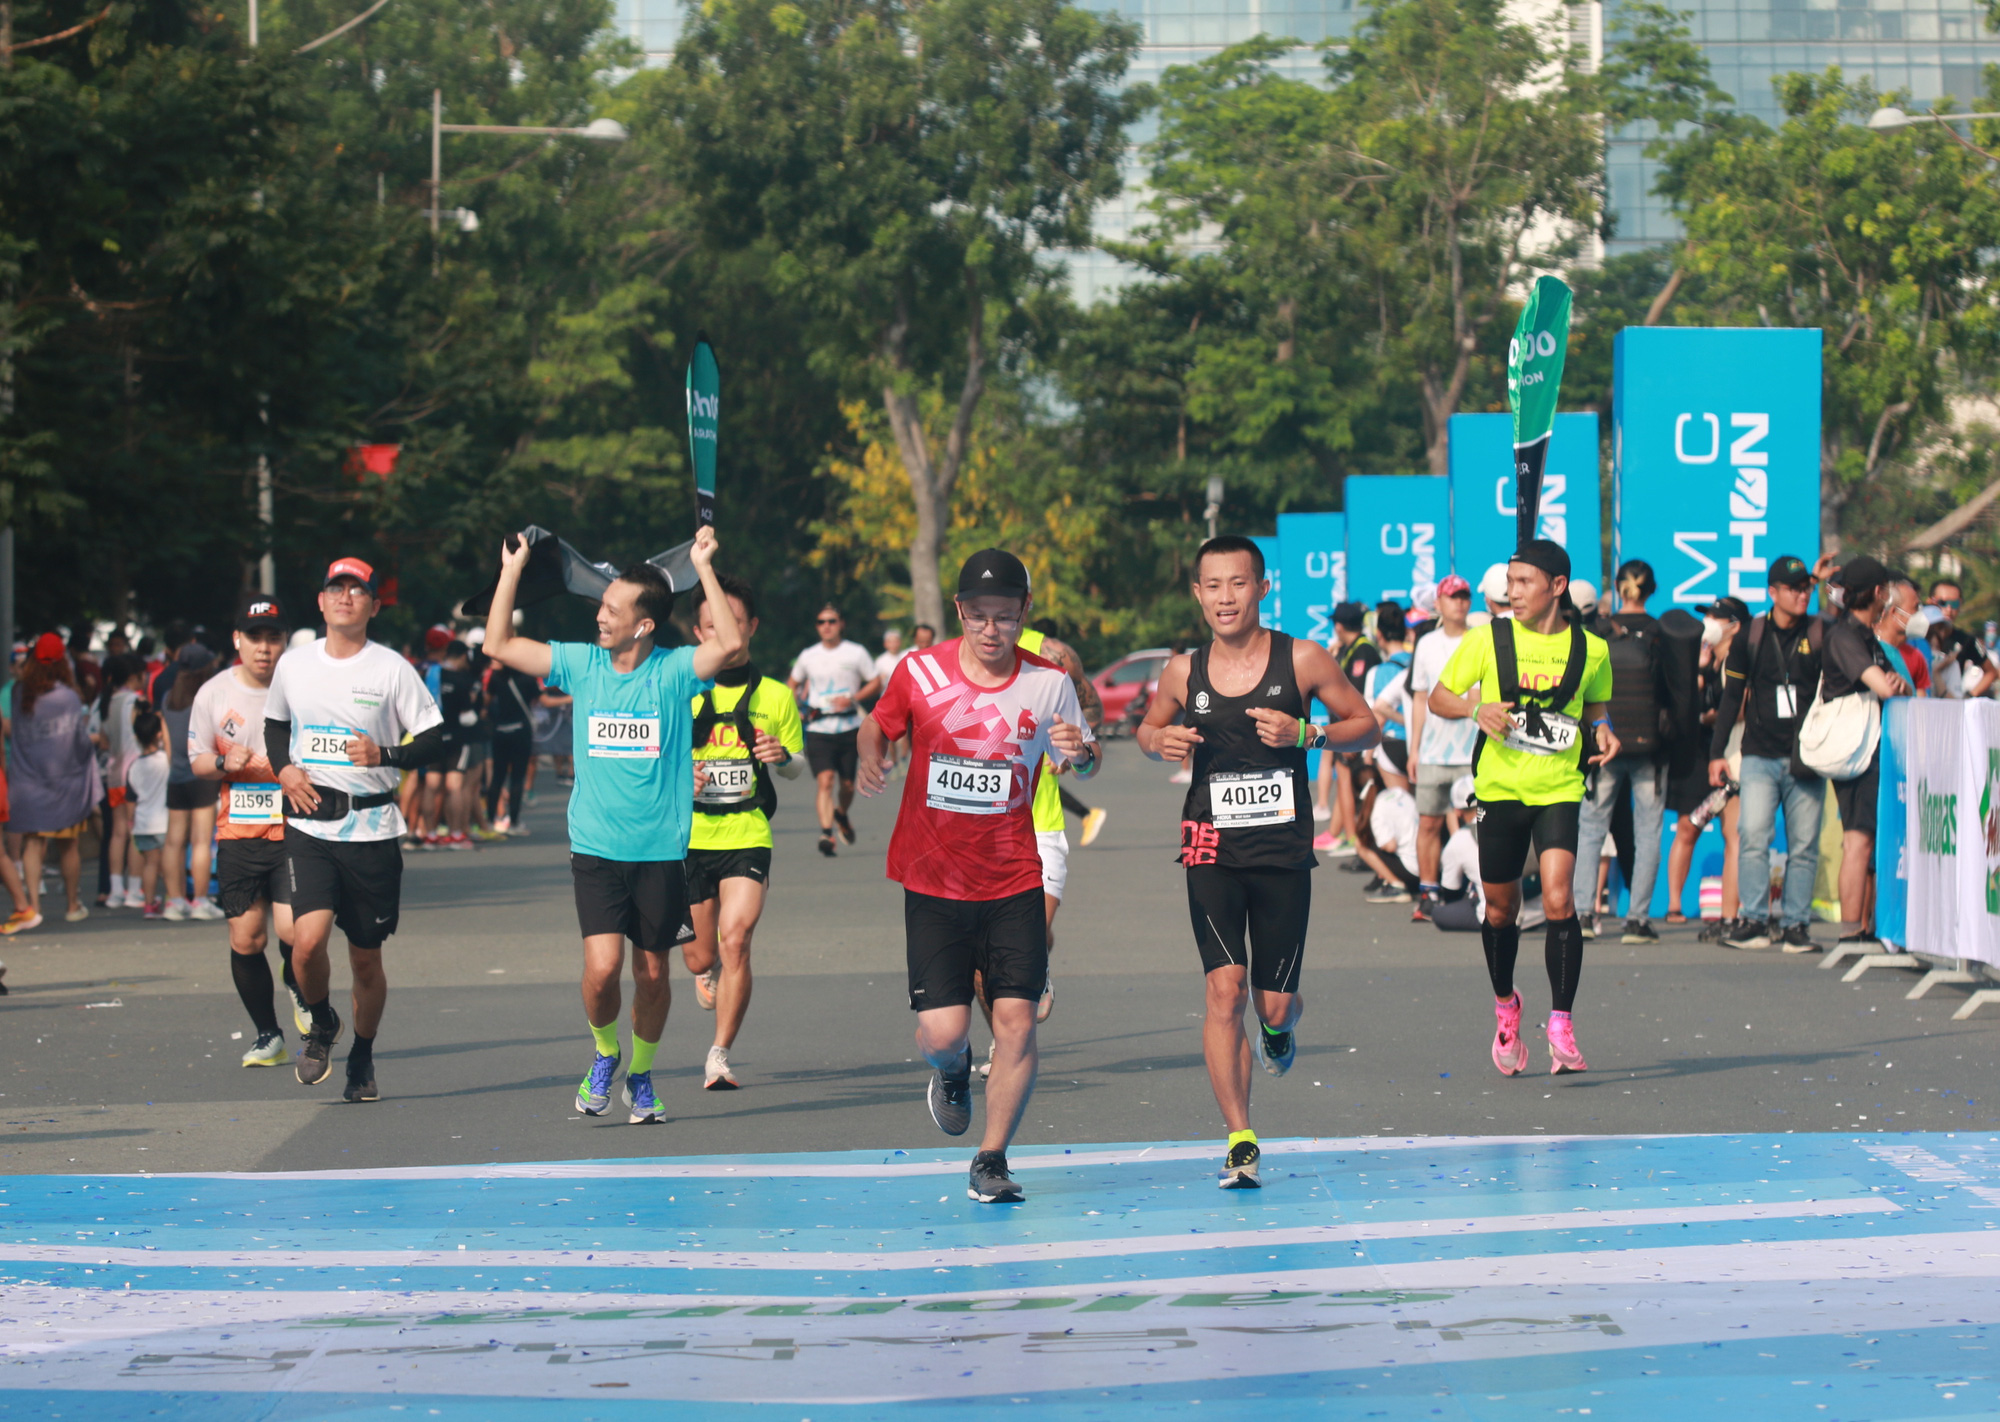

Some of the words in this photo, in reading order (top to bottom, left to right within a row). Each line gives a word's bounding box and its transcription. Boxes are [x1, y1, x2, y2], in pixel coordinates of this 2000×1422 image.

[1674, 412, 1720, 465] C
[1728, 412, 1770, 604] THON
[1380, 522, 1408, 555] C
[1305, 551, 1328, 578] C
[1672, 531, 1718, 604] M
[597, 722, 650, 740] 20780
[936, 769, 1001, 794] 40433
[1221, 783, 1282, 806] 40129
[234, 793, 274, 808] 21595
